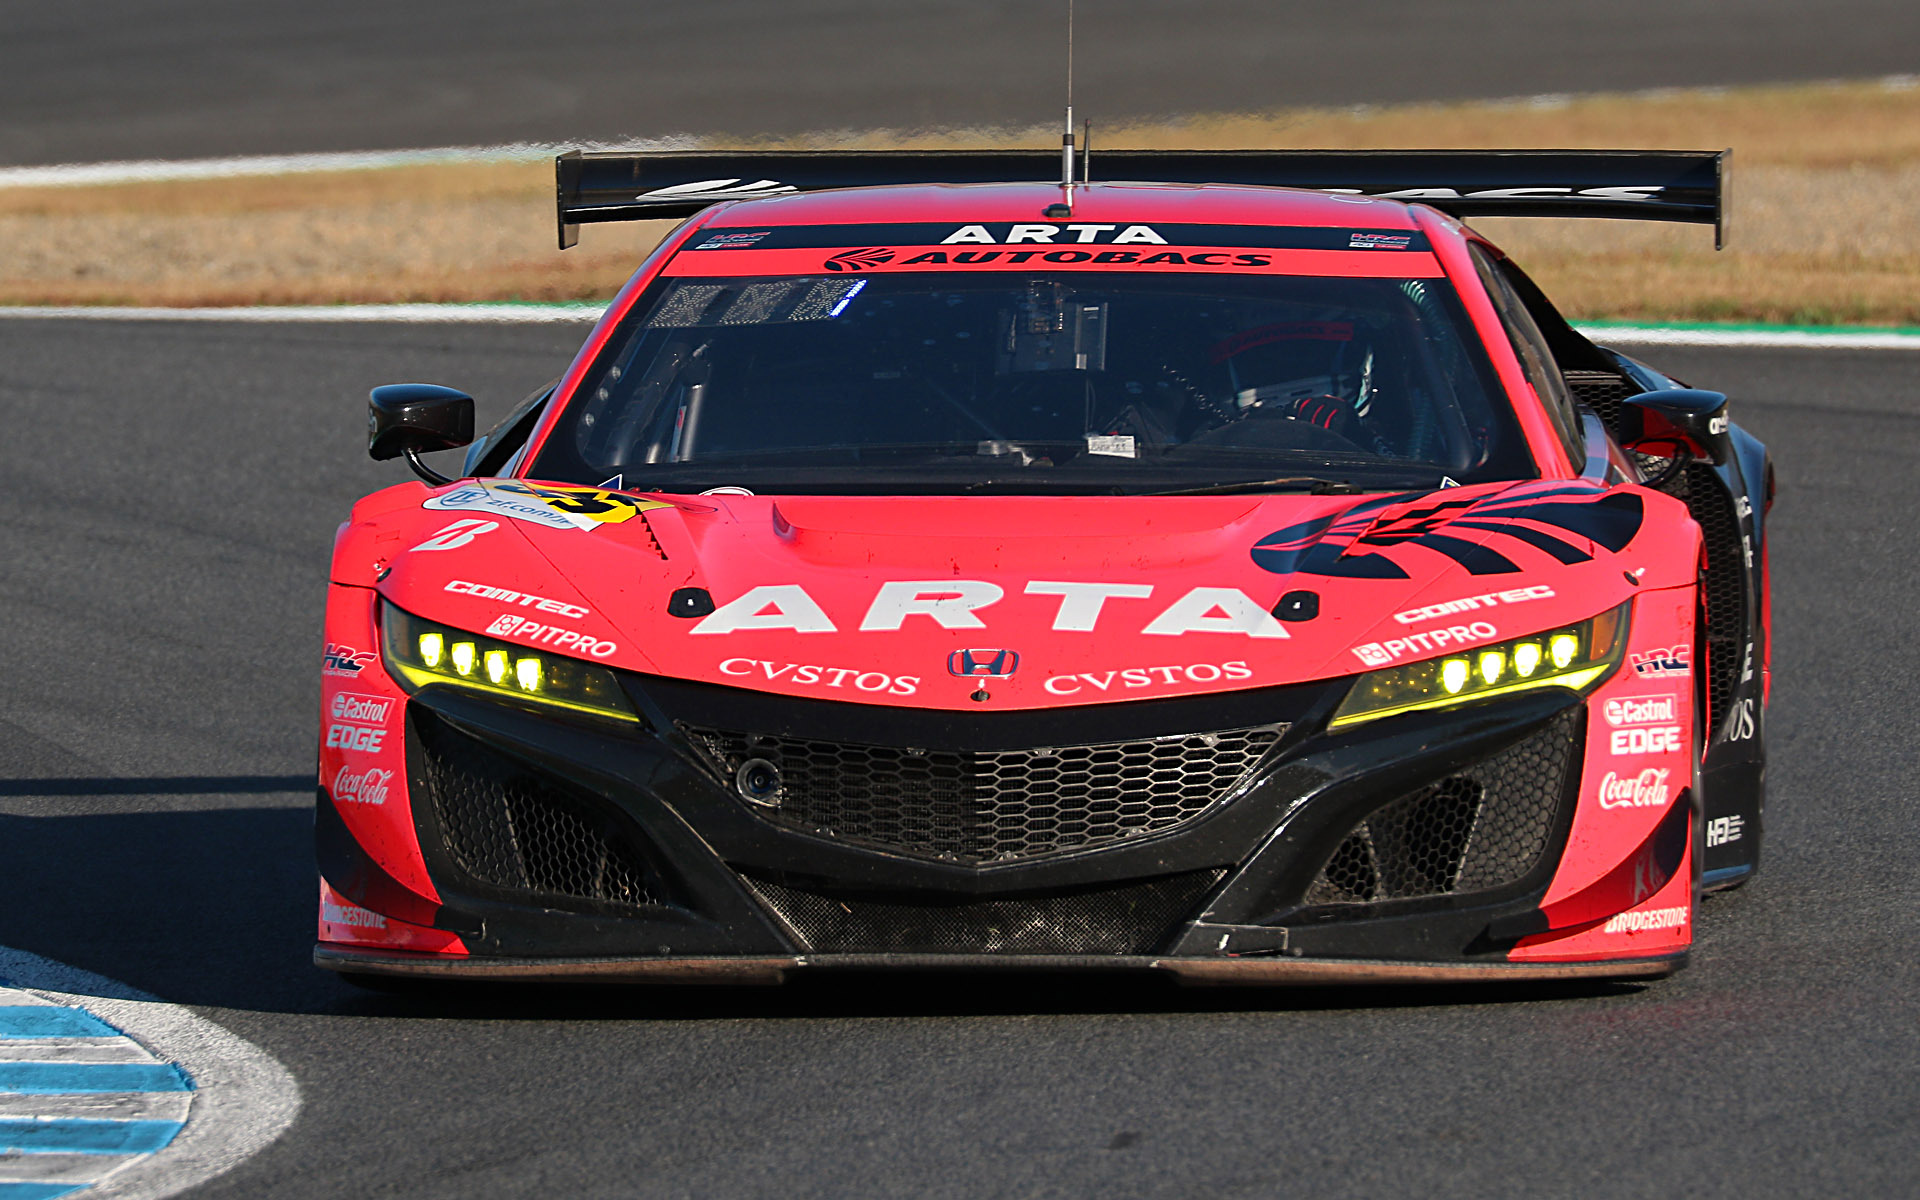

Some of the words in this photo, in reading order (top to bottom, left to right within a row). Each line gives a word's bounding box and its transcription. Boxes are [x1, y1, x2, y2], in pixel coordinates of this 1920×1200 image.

[939, 224, 1169, 245] ARTA
[897, 250, 1273, 267] AUTOBACS
[444, 580, 590, 619] COMTEC
[688, 580, 1291, 639] ARTA
[1393, 585, 1556, 624] COMTEC
[513, 620, 617, 658] PITPRO
[1383, 621, 1497, 658] PITPRO
[718, 657, 920, 696] CVSTOS
[1044, 660, 1252, 696] CVSTOS
[344, 697, 388, 721] Castrol
[1623, 698, 1673, 723] Castrol
[326, 724, 387, 752] EDGE
[1610, 726, 1681, 755] EDGE
[1604, 906, 1688, 933] BRIDGESTONE
